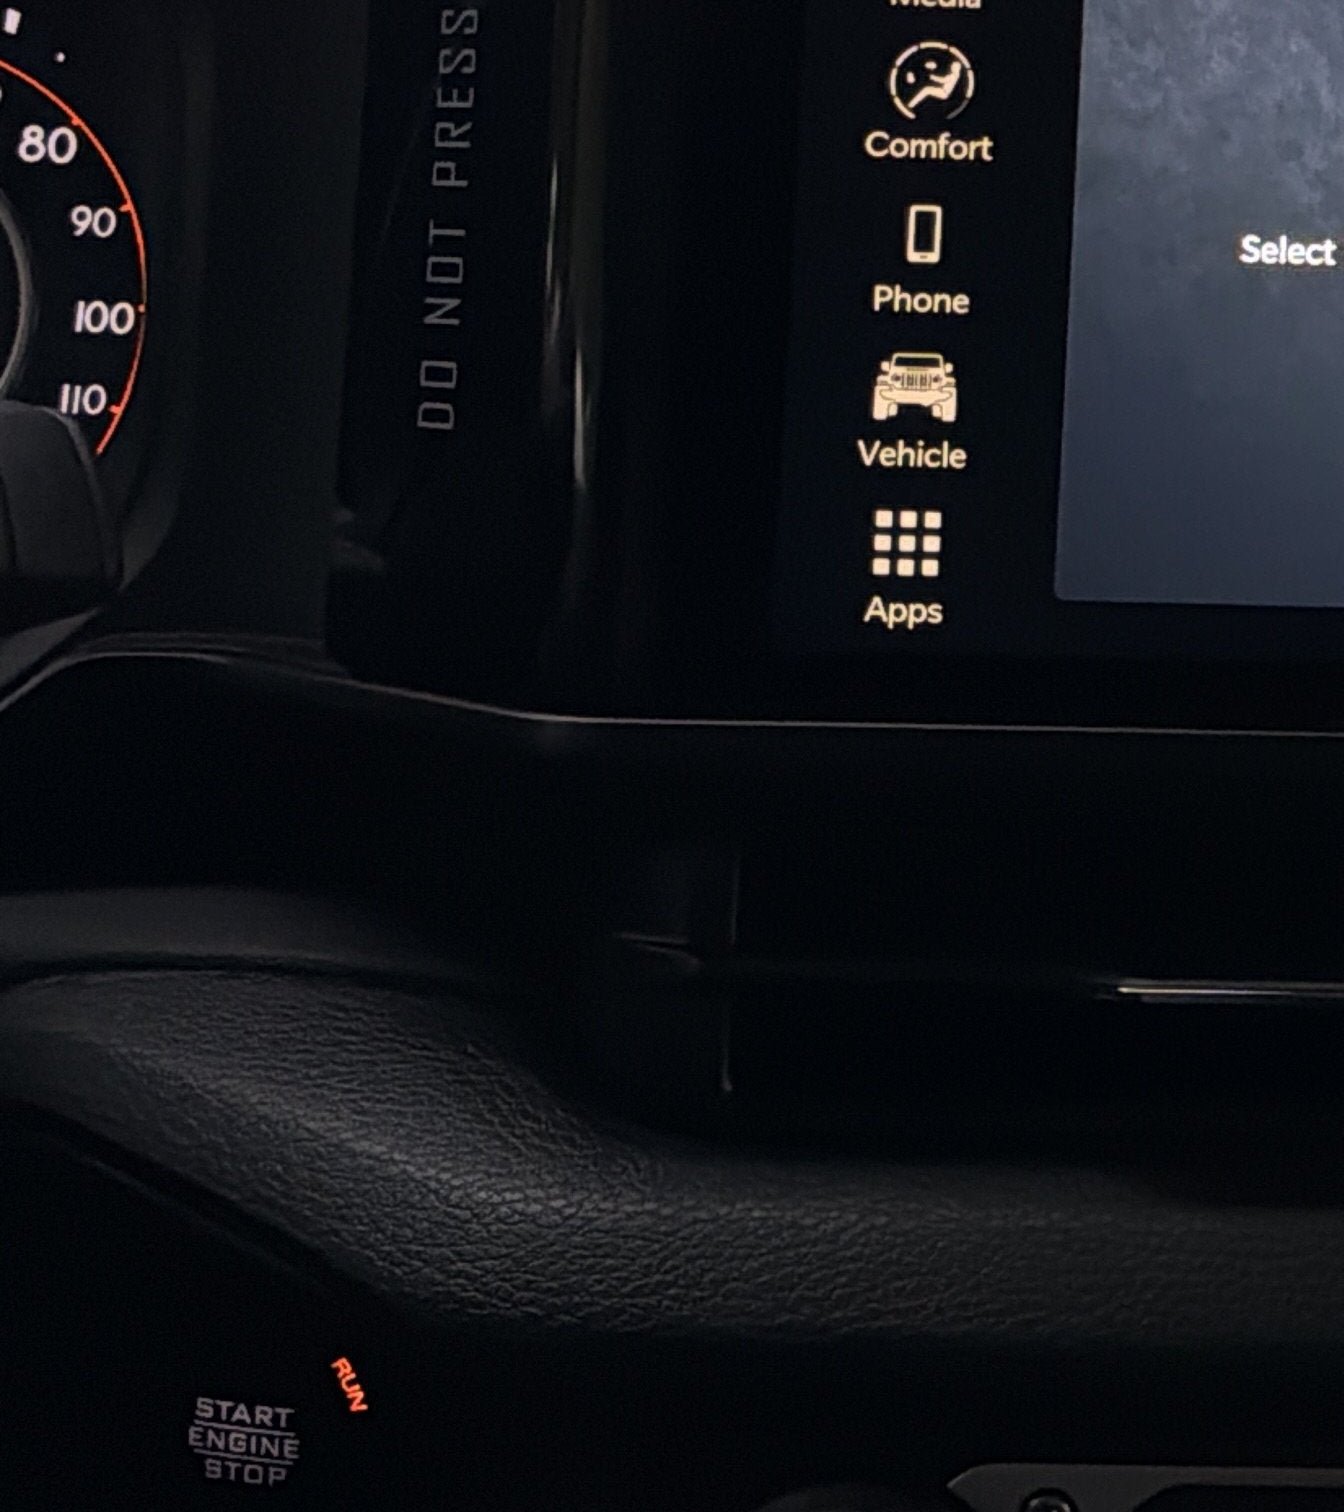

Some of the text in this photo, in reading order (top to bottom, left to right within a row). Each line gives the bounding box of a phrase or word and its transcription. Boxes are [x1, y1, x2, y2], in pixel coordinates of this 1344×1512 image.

[17, 124, 78, 165] 80
[864, 129, 994, 163] Comfort
[70, 204, 117, 238] 90
[416, 7, 480, 431] DO NOT PRESS
[1239, 234, 1338, 267] Select
[873, 284, 971, 316] Phone
[74, 299, 136, 336] 100
[59, 383, 108, 416] 110
[857, 438, 968, 471] Vehicle
[863, 597, 944, 630] Apps
[330, 1356, 369, 1413] RUN
[195, 1396, 296, 1429] START
[187, 1424, 300, 1460] ENGINE
[204, 1457, 288, 1487] STOP
